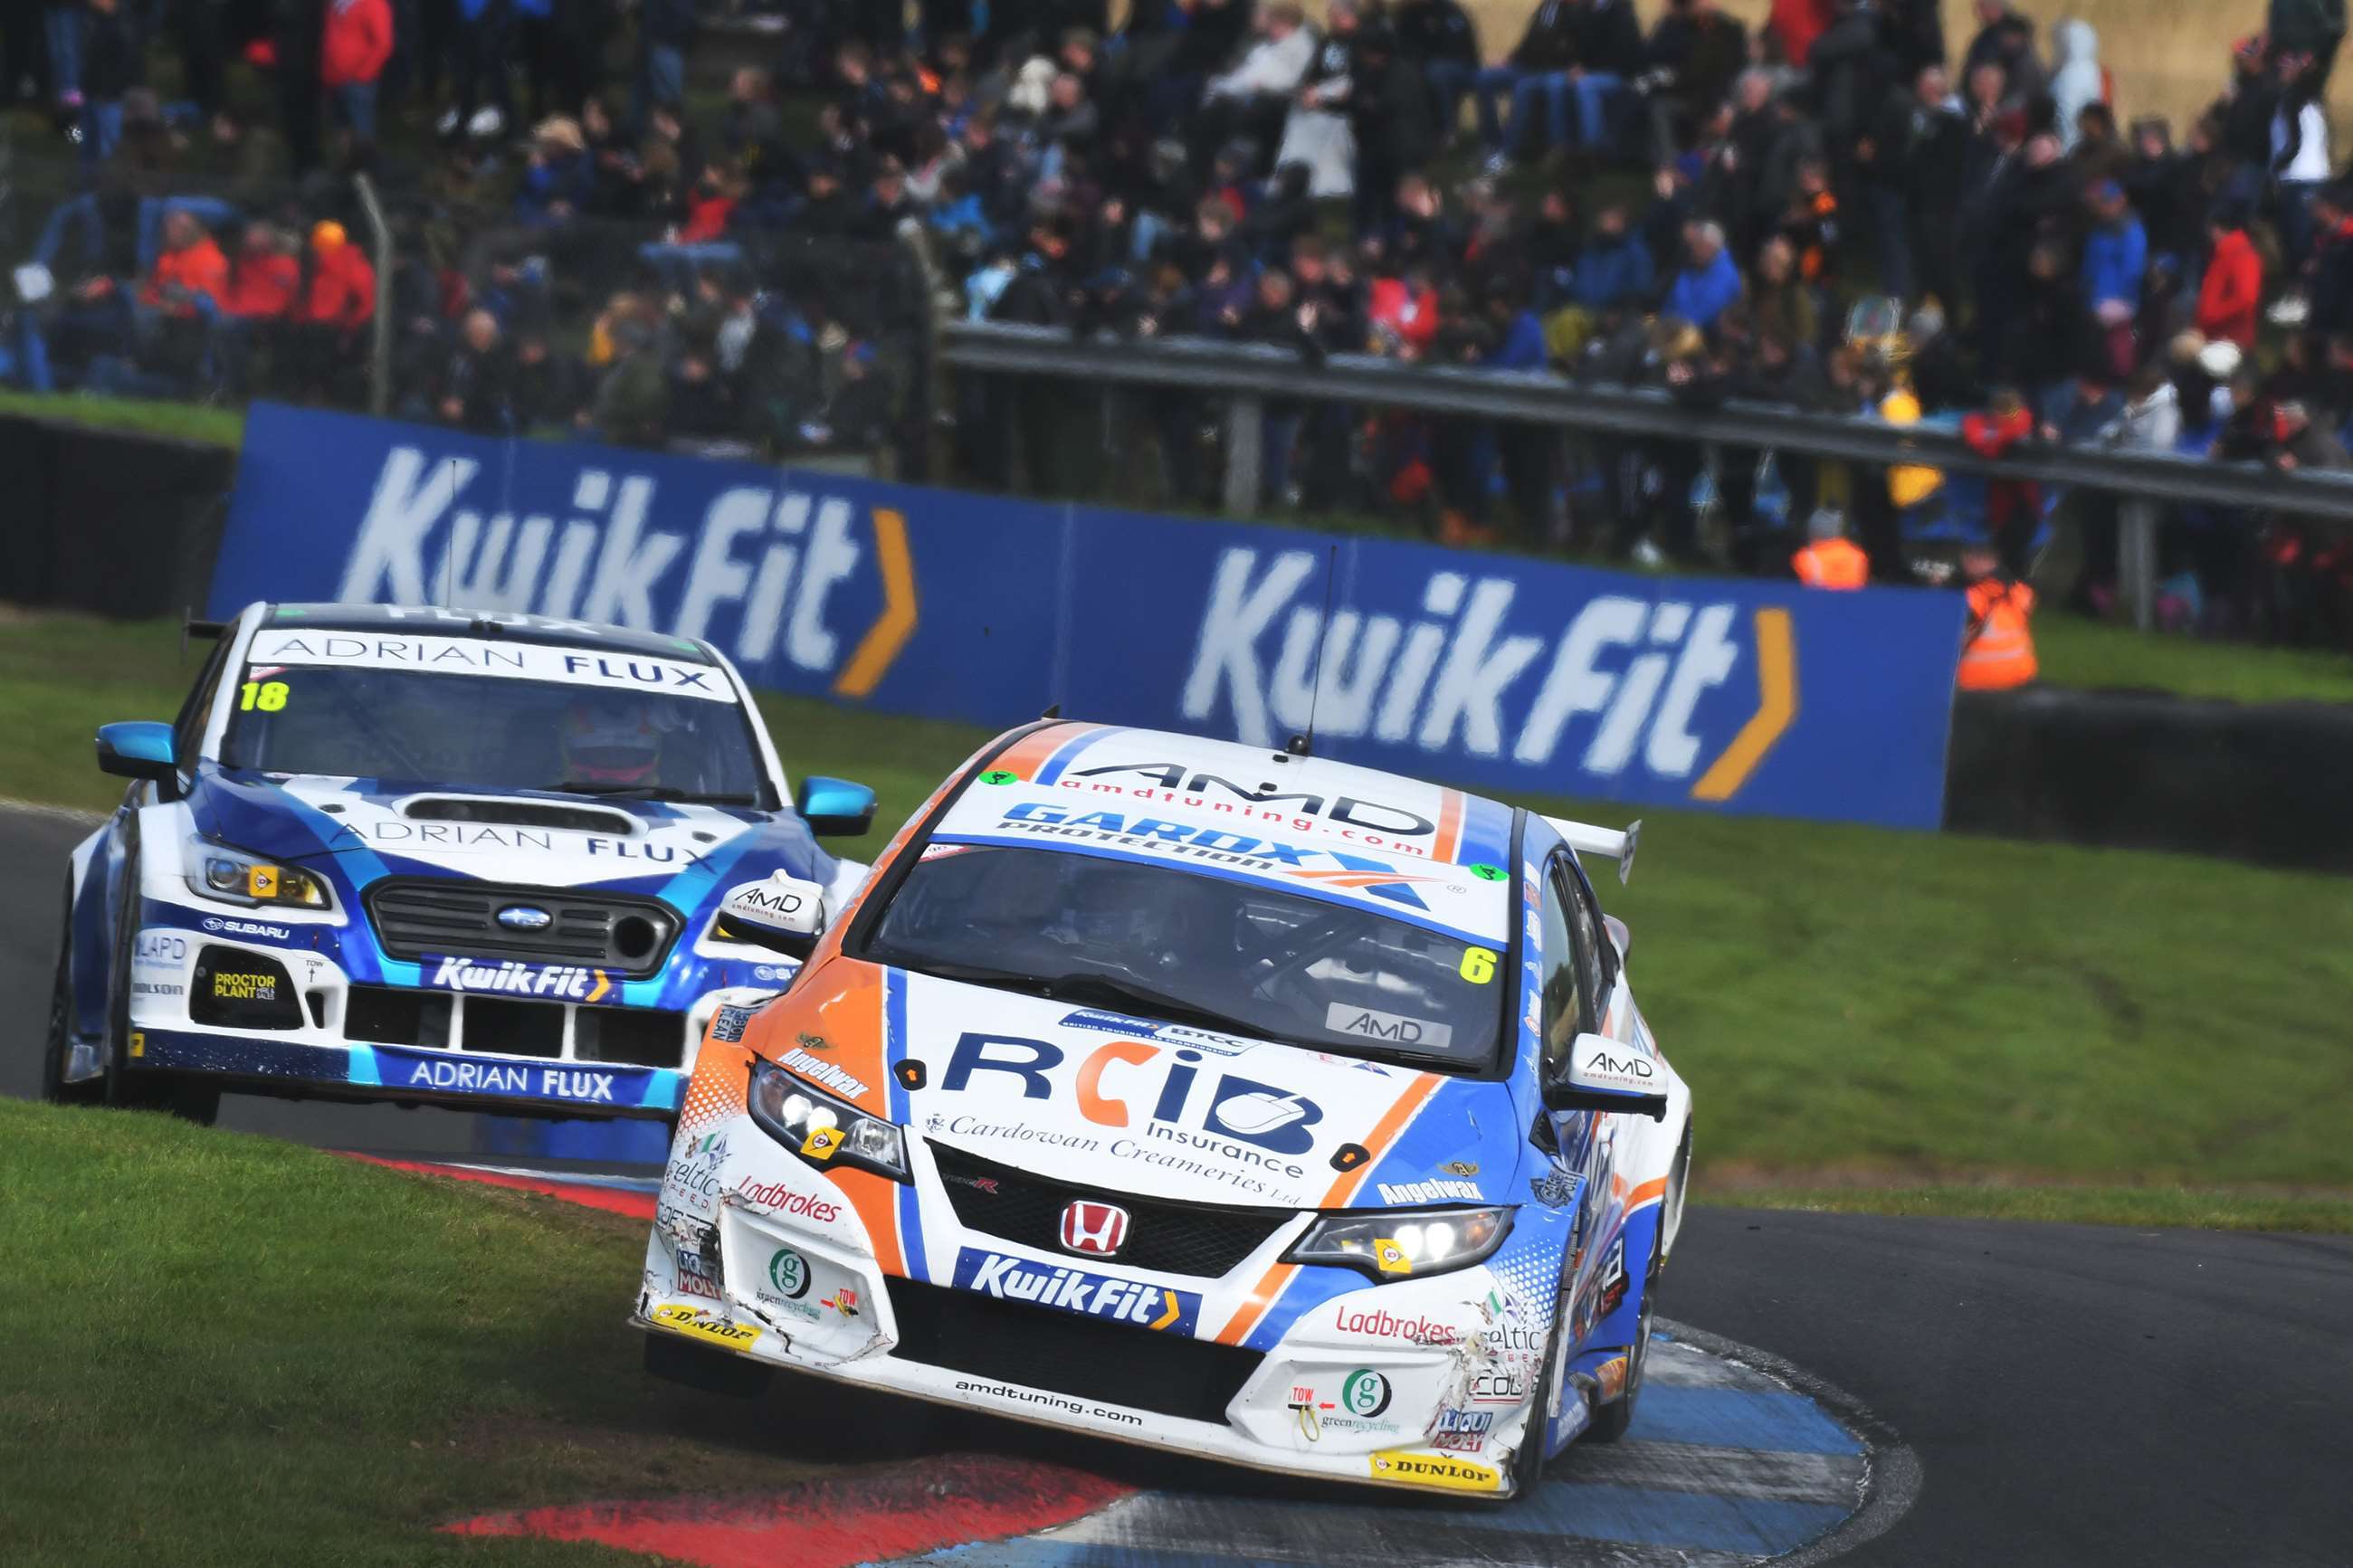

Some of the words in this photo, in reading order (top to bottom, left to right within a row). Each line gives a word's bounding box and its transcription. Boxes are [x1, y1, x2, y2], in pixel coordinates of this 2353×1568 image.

[271, 638, 525, 669] ADRIAN
[564, 655, 714, 692] FLUX
[241, 681, 290, 711] 18
[1069, 762, 1436, 836] AMD
[1061, 779, 1424, 856] amdtuning.com
[329, 822, 551, 850] ADRIAN
[586, 837, 717, 875] FLUX
[996, 821, 1274, 870] PROTECTION
[734, 888, 802, 913] AMD
[224, 921, 290, 939] SUBARU
[216, 974, 276, 988] PROCTOR
[1460, 946, 1497, 984] 6
[215, 984, 256, 999] PLANT
[1171, 1028, 1243, 1048] BTCC
[1345, 1012, 1422, 1043] AMD
[410, 1060, 528, 1092] ADRIAN
[543, 1069, 614, 1101] FLUX
[777, 1047, 870, 1099] Angelwax
[1586, 1052, 1653, 1077] AMD
[950, 1115, 1100, 1152] Cardowan
[1110, 1140, 1267, 1193] Creameries
[1147, 1121, 1304, 1179] Insurance
[738, 1175, 843, 1223] Ladbrokes
[1376, 1177, 1484, 1206] Angelwax
[839, 1288, 857, 1306] TOW
[673, 1311, 753, 1340] DNLOP
[1336, 1306, 1456, 1345] Ladbrokes
[955, 1380, 1142, 1426] amdtuning.com
[1292, 1386, 1314, 1402] TOW
[1396, 1459, 1491, 1482] DUNLOP
